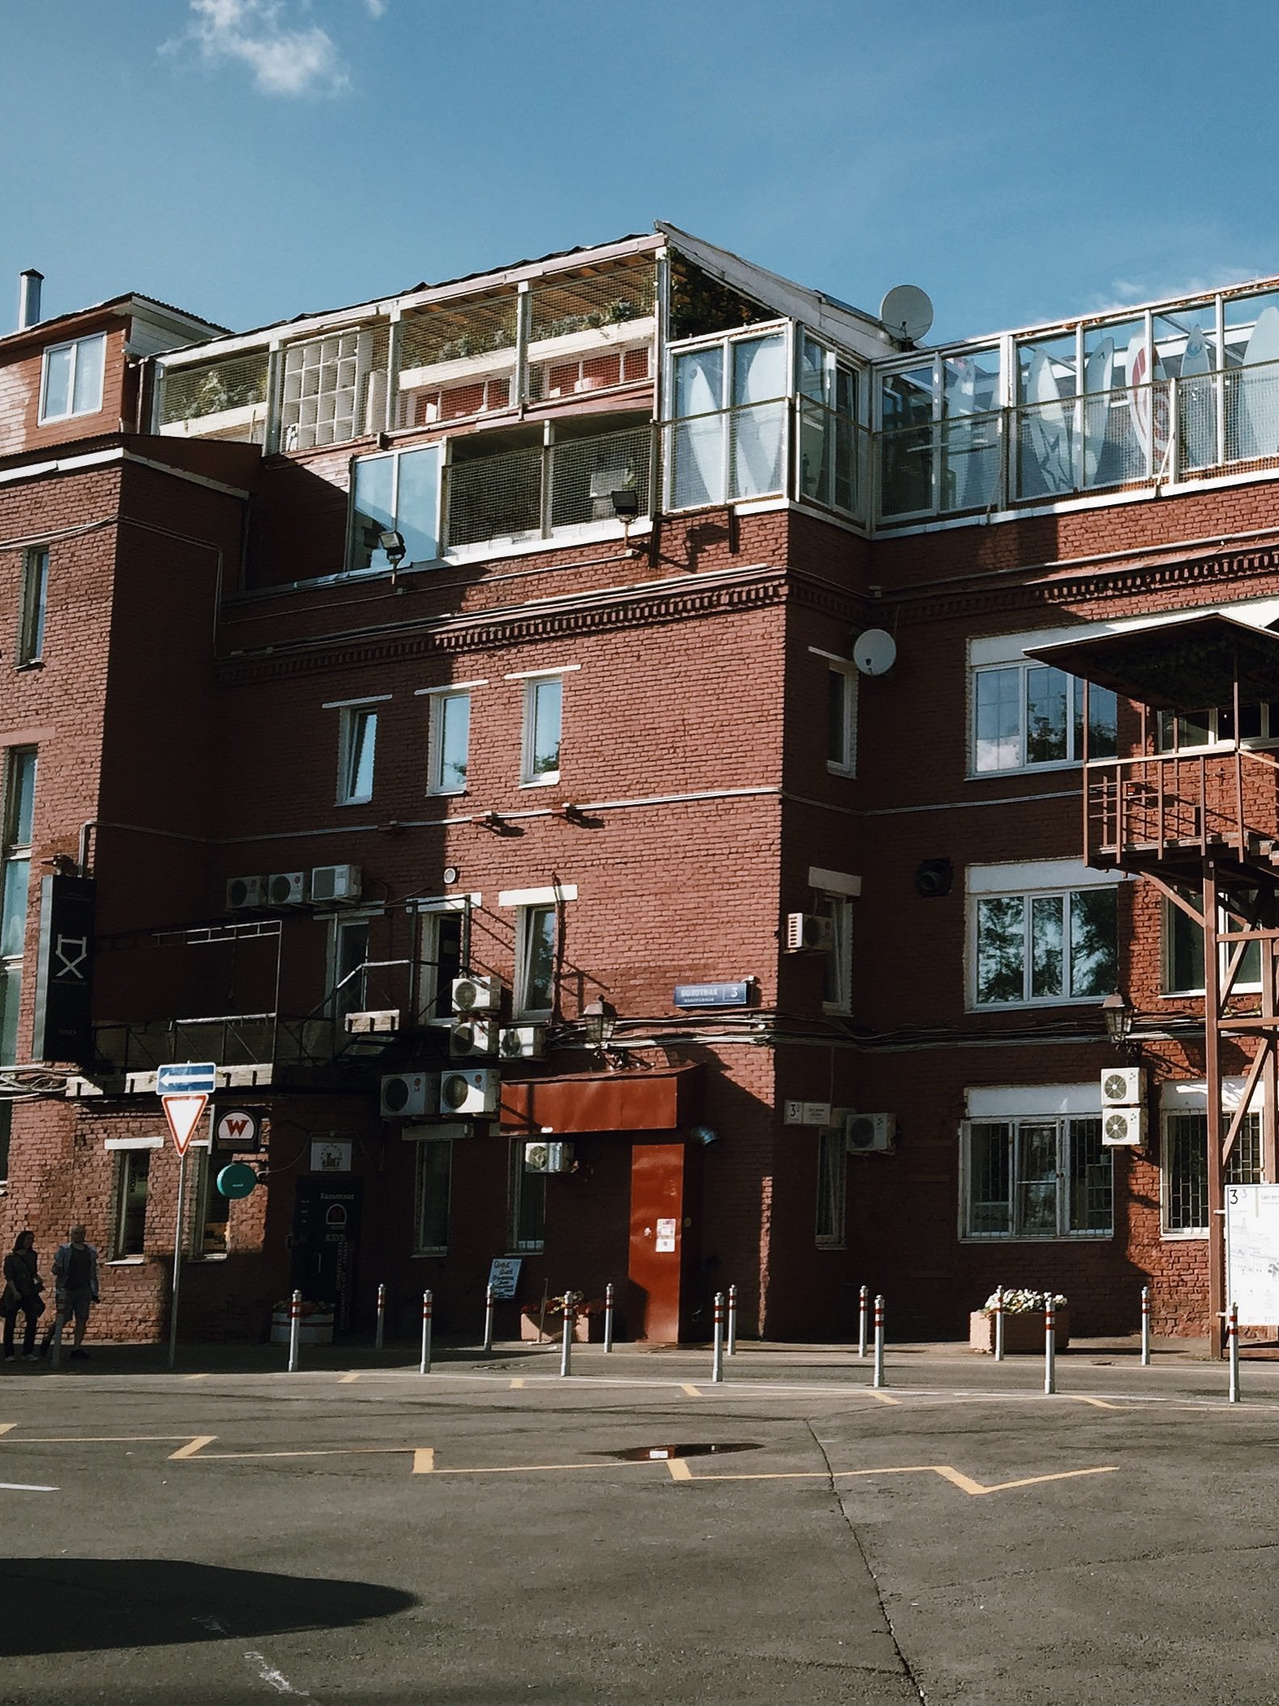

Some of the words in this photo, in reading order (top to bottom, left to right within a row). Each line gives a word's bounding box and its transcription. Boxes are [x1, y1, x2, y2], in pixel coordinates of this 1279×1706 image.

[731, 987, 739, 998] 3
[225, 1119, 249, 1137] W
[1229, 1189, 1239, 1205] 3
